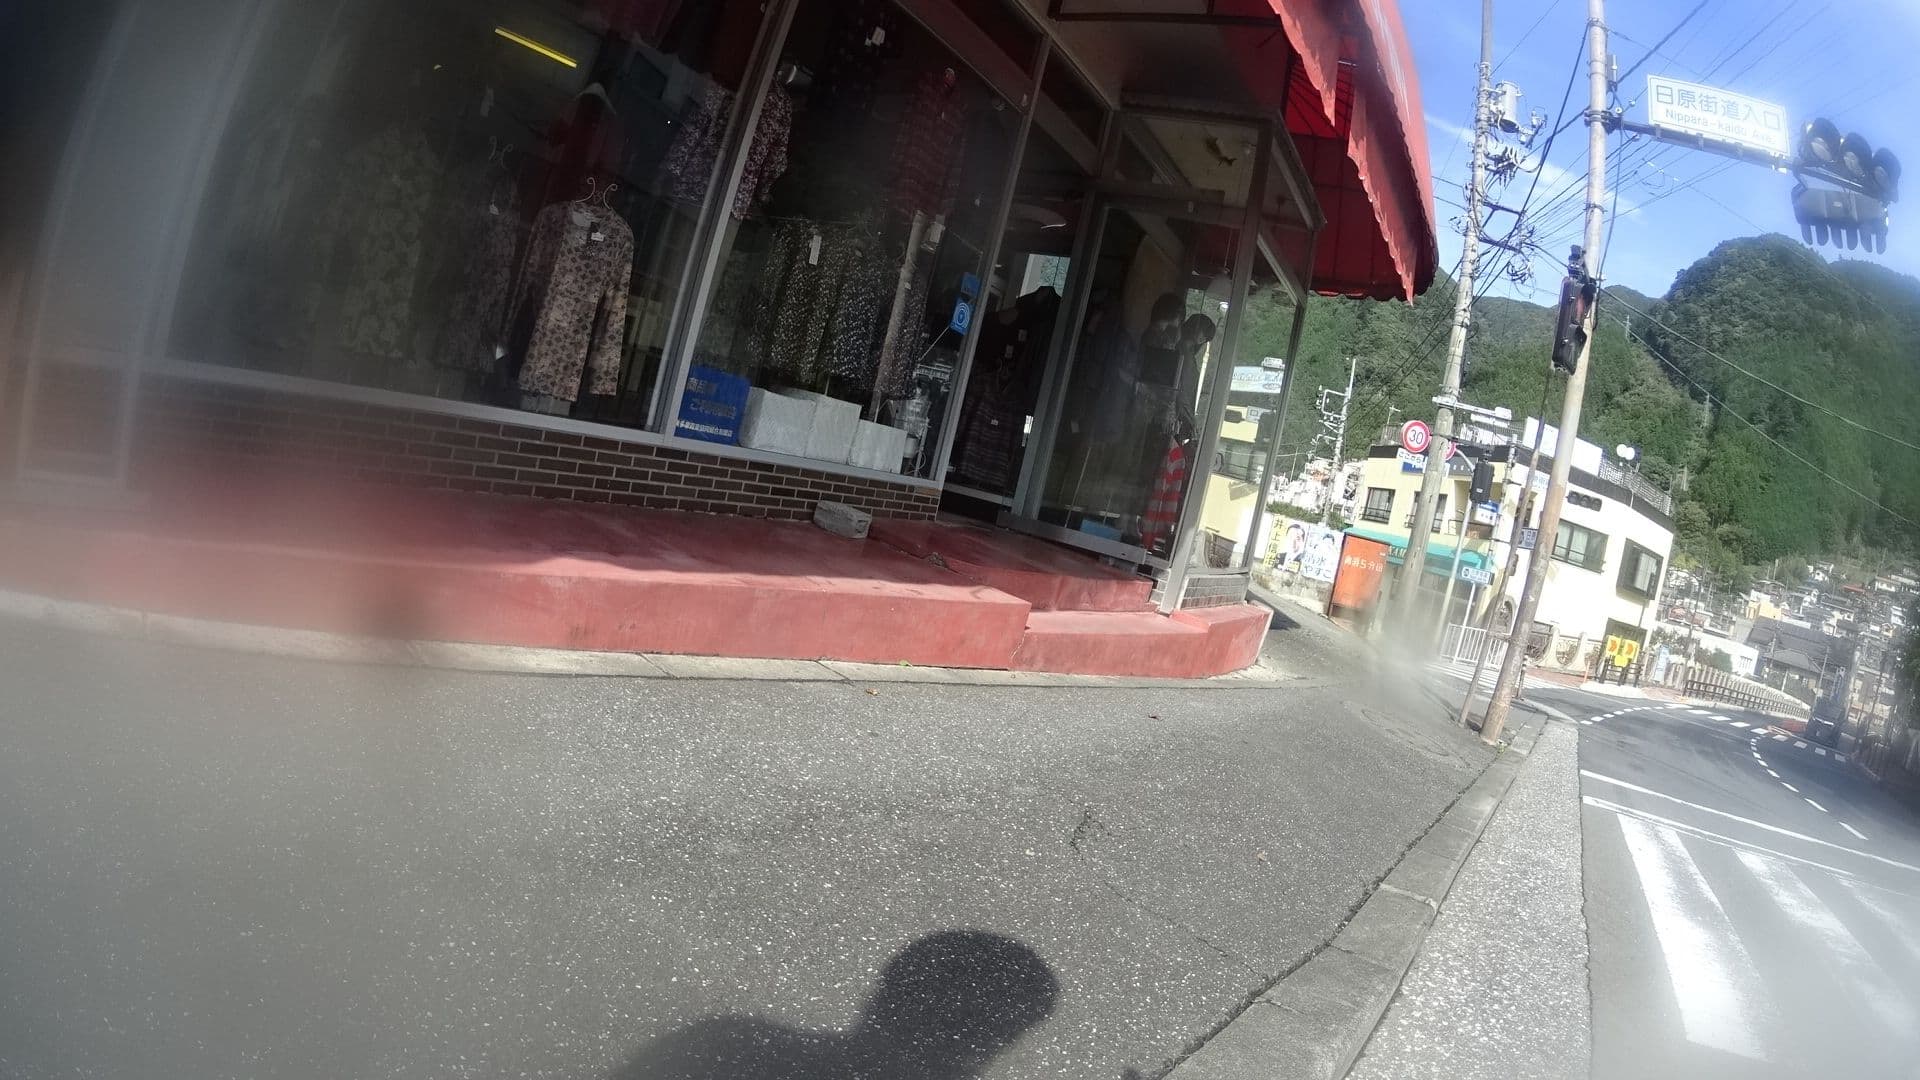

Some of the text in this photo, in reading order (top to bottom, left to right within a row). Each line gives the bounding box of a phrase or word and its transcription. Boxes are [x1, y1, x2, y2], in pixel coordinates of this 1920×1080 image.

[1656, 85, 1780, 129] 日原街道入口
[1409, 429, 1424, 445] 30
[1304, 565, 1332, 579] やすこ
